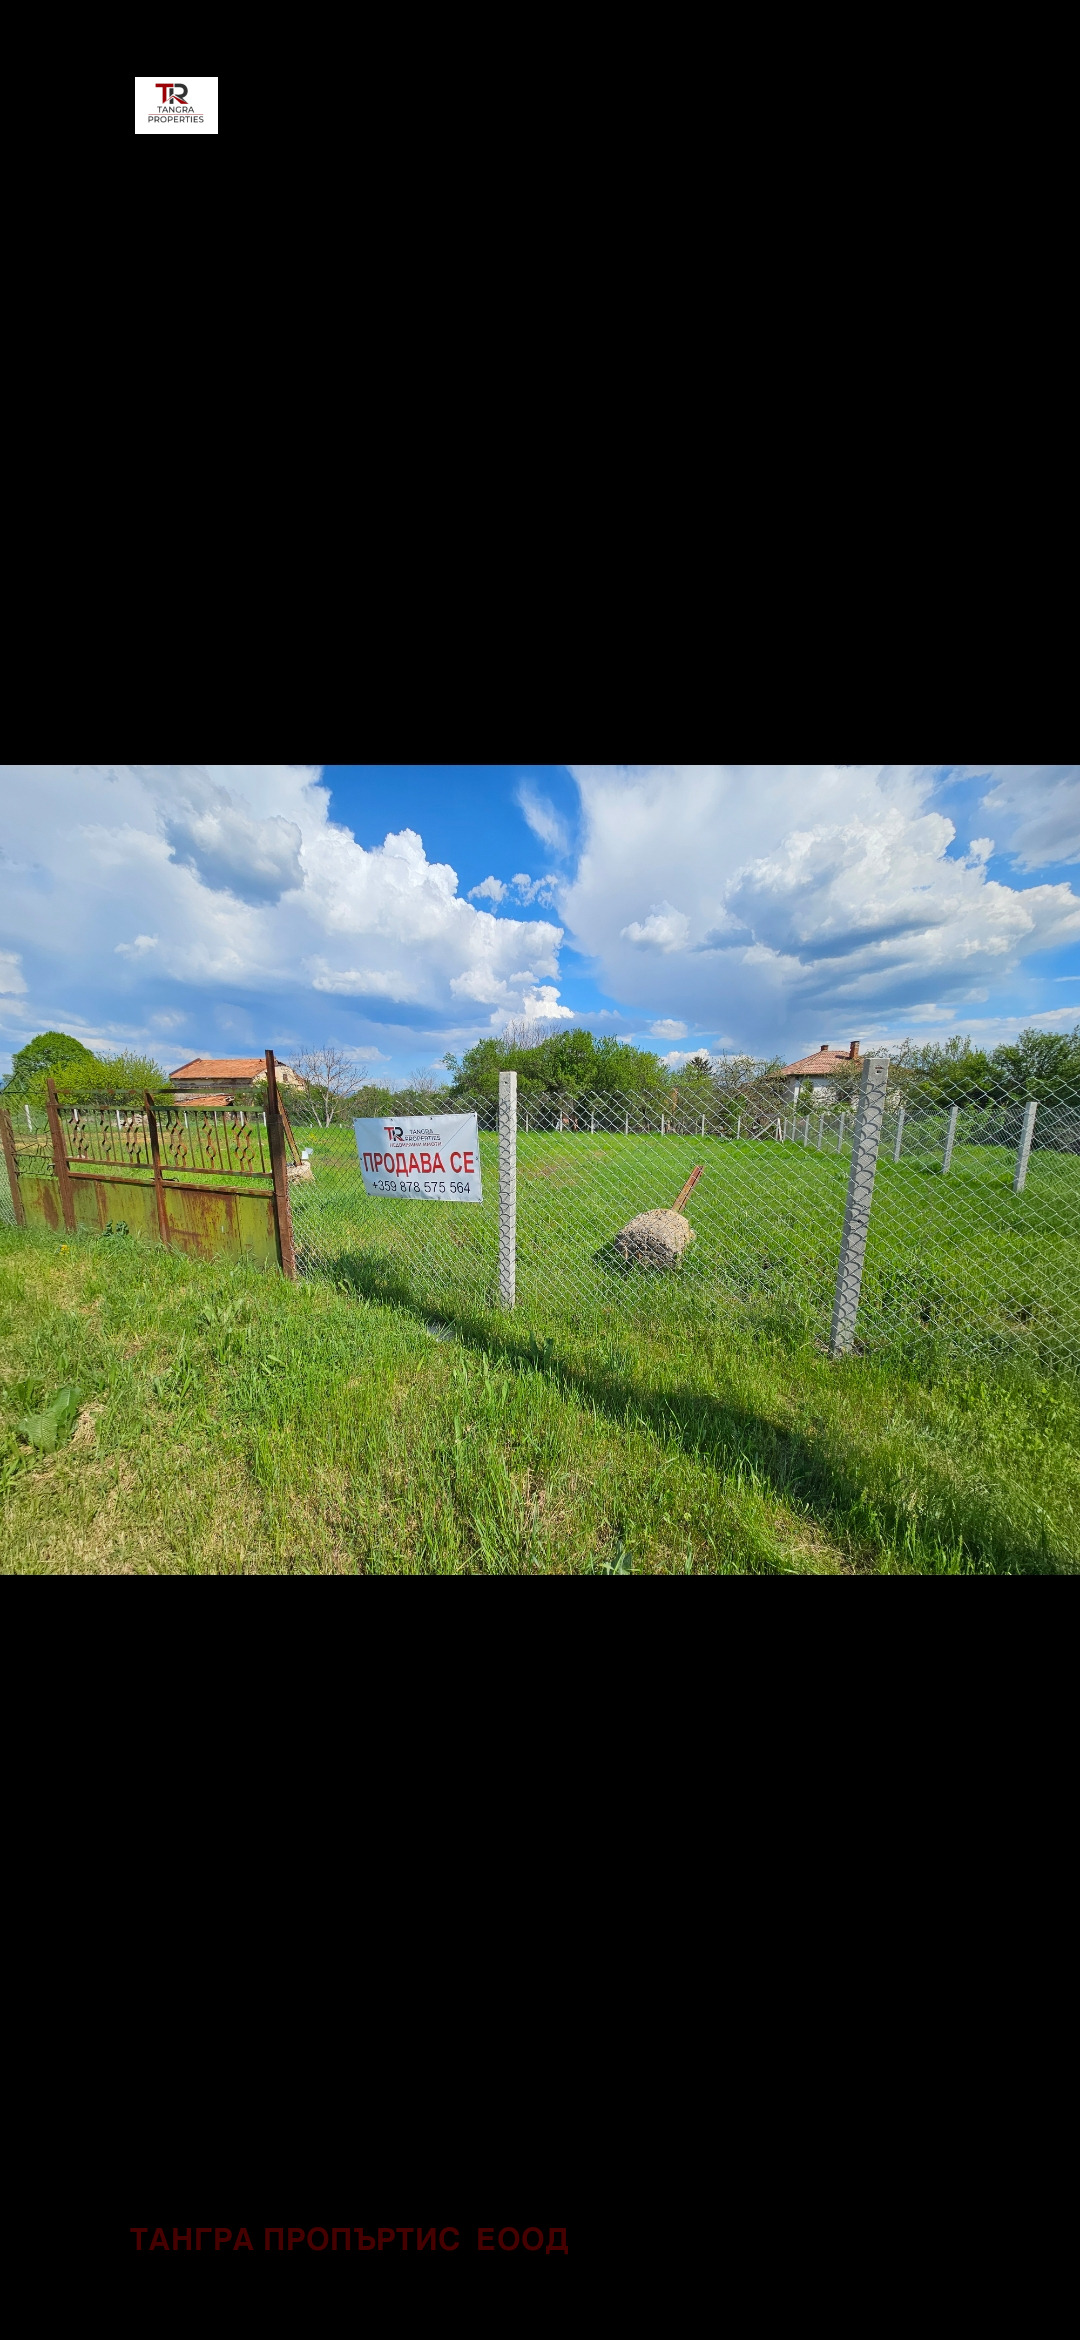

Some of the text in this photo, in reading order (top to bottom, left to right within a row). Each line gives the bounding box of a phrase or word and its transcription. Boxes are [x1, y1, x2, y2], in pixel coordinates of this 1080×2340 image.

[363, 1152, 474, 1177] ПРОДАВА СЕ
[372, 1180, 471, 1194] +359 878 575 564
